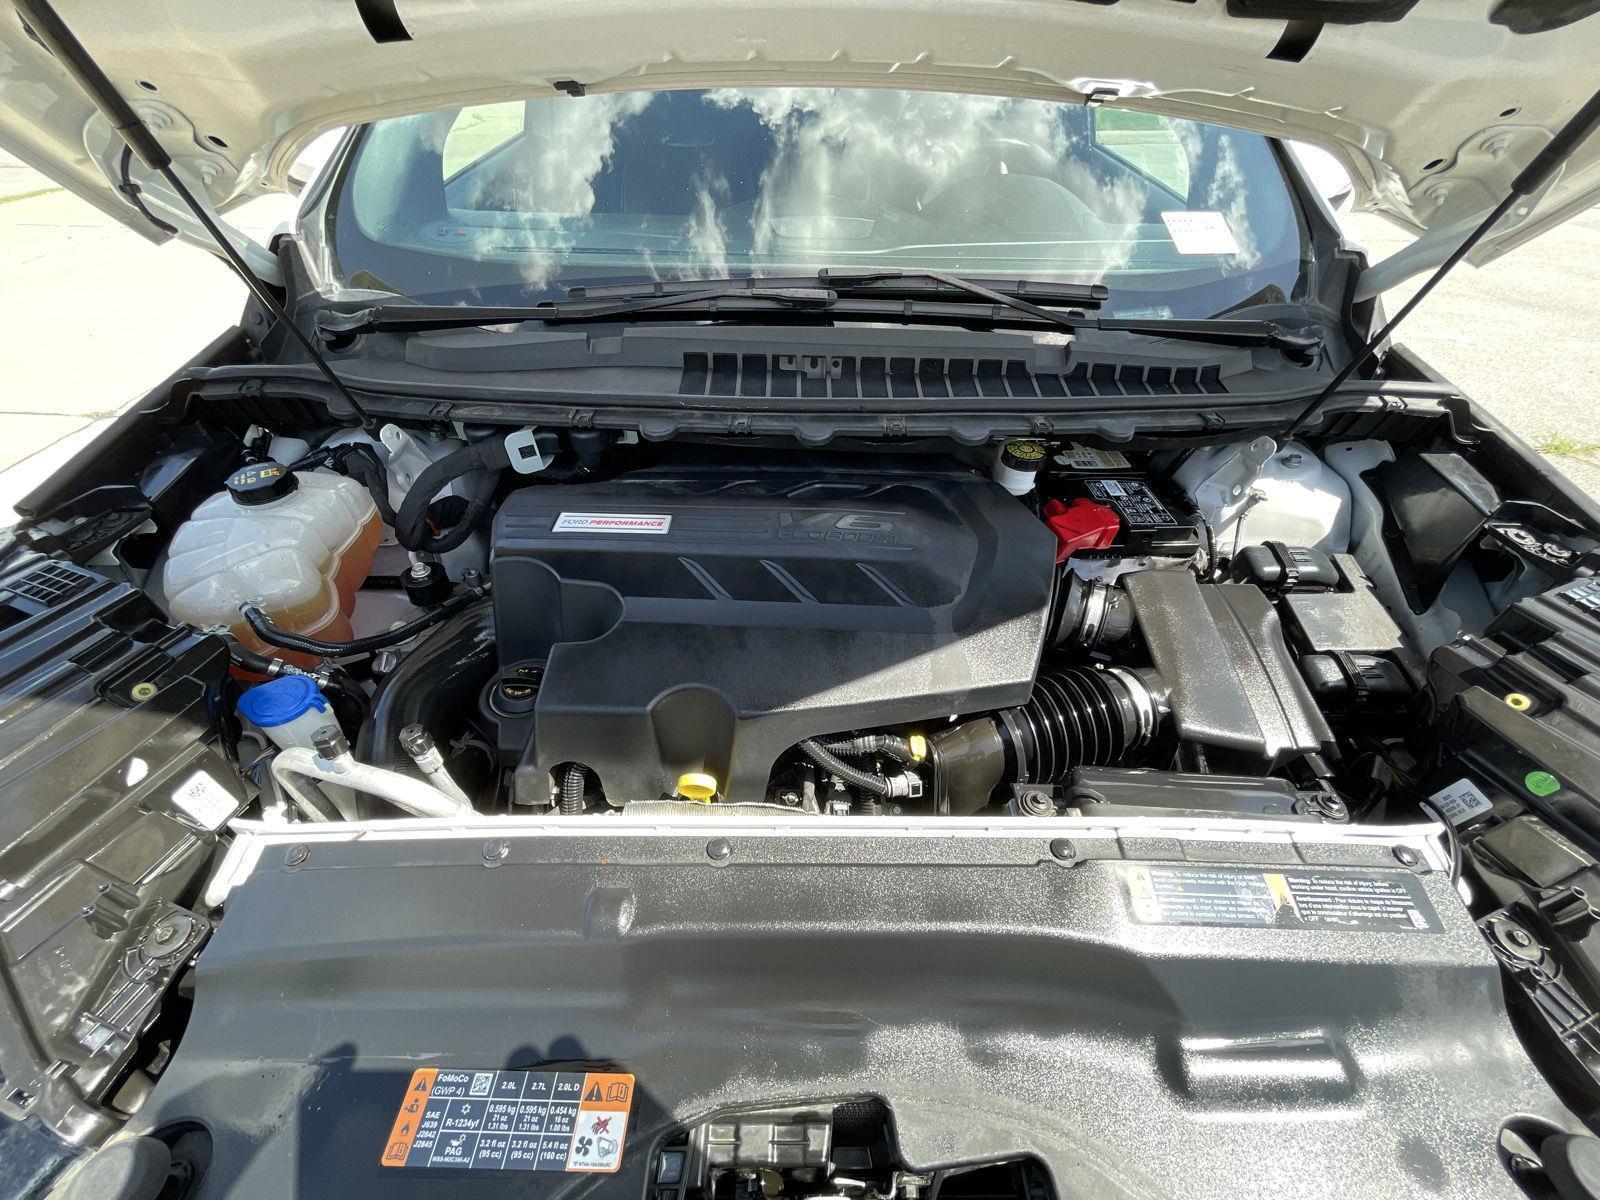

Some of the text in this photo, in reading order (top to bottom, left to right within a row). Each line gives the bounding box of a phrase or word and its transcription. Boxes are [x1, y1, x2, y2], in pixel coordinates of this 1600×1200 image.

[438, 1074, 469, 1082] FoMoCo
[502, 1082, 516, 1090] 2.0L
[532, 1082, 546, 1090] 2.7L
[431, 1086, 465, 1098] (GWP 4)
[489, 1104, 516, 1115] 0.595 kg
[520, 1105, 546, 1116] 0.595 kg
[550, 1106, 577, 1117] 0.454 kg
[446, 1118, 480, 1130] R-1234yf
[480, 1139, 490, 1147] 3.2
[511, 1140, 522, 1148] 3.2
[523, 1140, 528, 1148] fl
[542, 1141, 553, 1149] 5.4
[554, 1141, 559, 1149] fl
[444, 1146, 463, 1156] PAG
[479, 1150, 502, 1159] (95 cc)
[511, 1151, 534, 1160] (95 cc)
[540, 1152, 566, 1161] (160 cc)
